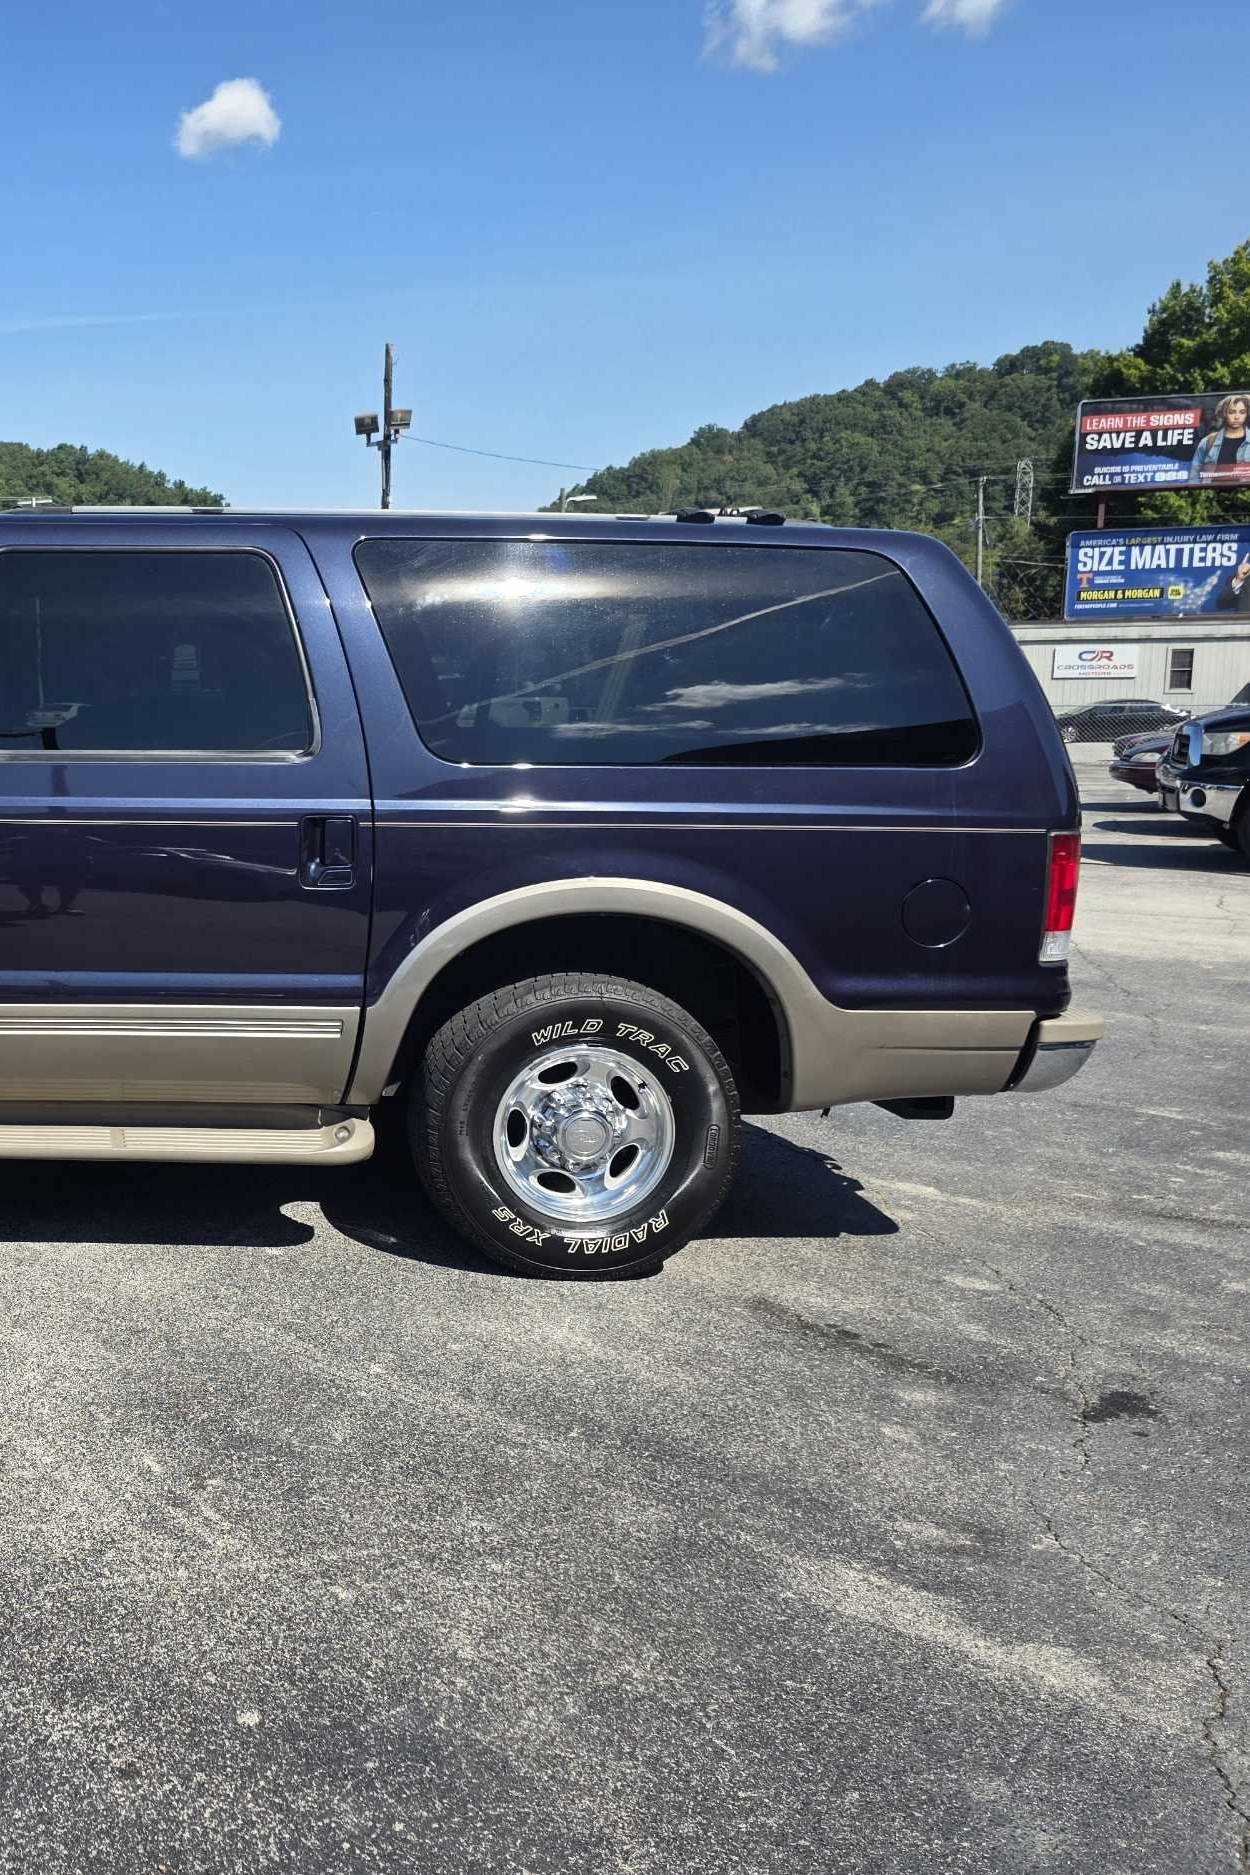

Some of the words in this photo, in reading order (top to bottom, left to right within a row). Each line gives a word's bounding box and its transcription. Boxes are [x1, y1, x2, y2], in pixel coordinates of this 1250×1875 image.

[1086, 417, 1124, 431] LEARN
[1126, 415, 1147, 428] THE
[1149, 412, 1195, 427] SIGNS
[1085, 431, 1136, 450] SAVE
[1138, 430, 1153, 447] A
[1156, 428, 1195, 446] LIFE
[1083, 474, 1112, 486] CALL
[1123, 472, 1154, 484] TEXT
[1077, 546, 1127, 572] SIZE
[1130, 542, 1239, 570] MATTERS
[1080, 590, 1115, 601] MORGAN
[1125, 588, 1161, 599] MORGAN
[531, 1018, 603, 1046] WILD
[616, 1023, 690, 1073] TRAC
[491, 1206, 551, 1247] XRS
[563, 1209, 670, 1254] RADIAL
